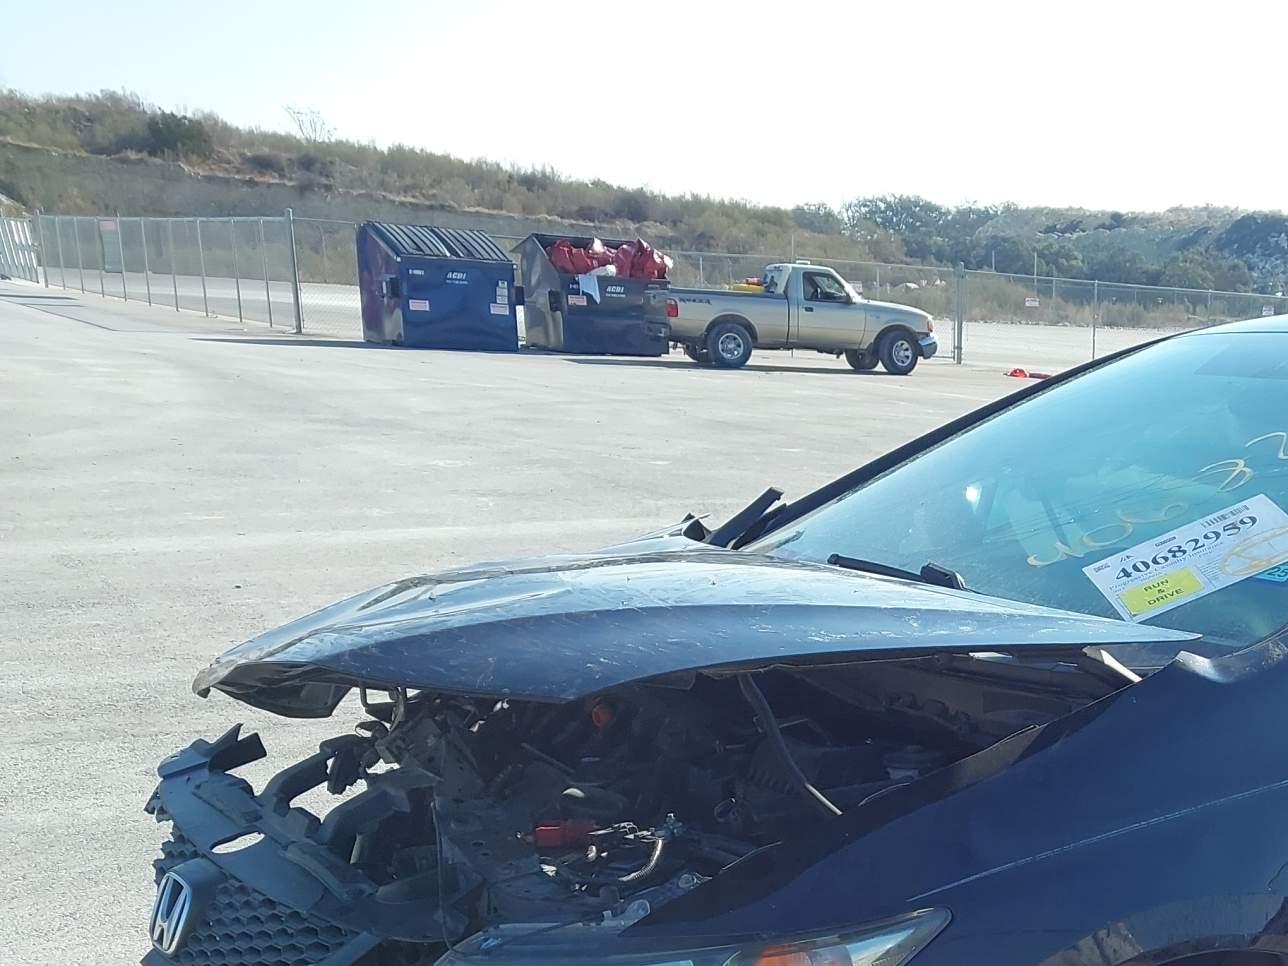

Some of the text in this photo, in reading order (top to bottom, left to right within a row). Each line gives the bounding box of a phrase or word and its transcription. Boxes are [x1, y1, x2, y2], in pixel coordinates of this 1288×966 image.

[1114, 514, 1258, 581] 40682959
[1143, 578, 1170, 593] RUN
[1147, 587, 1185, 606] DRIVE
